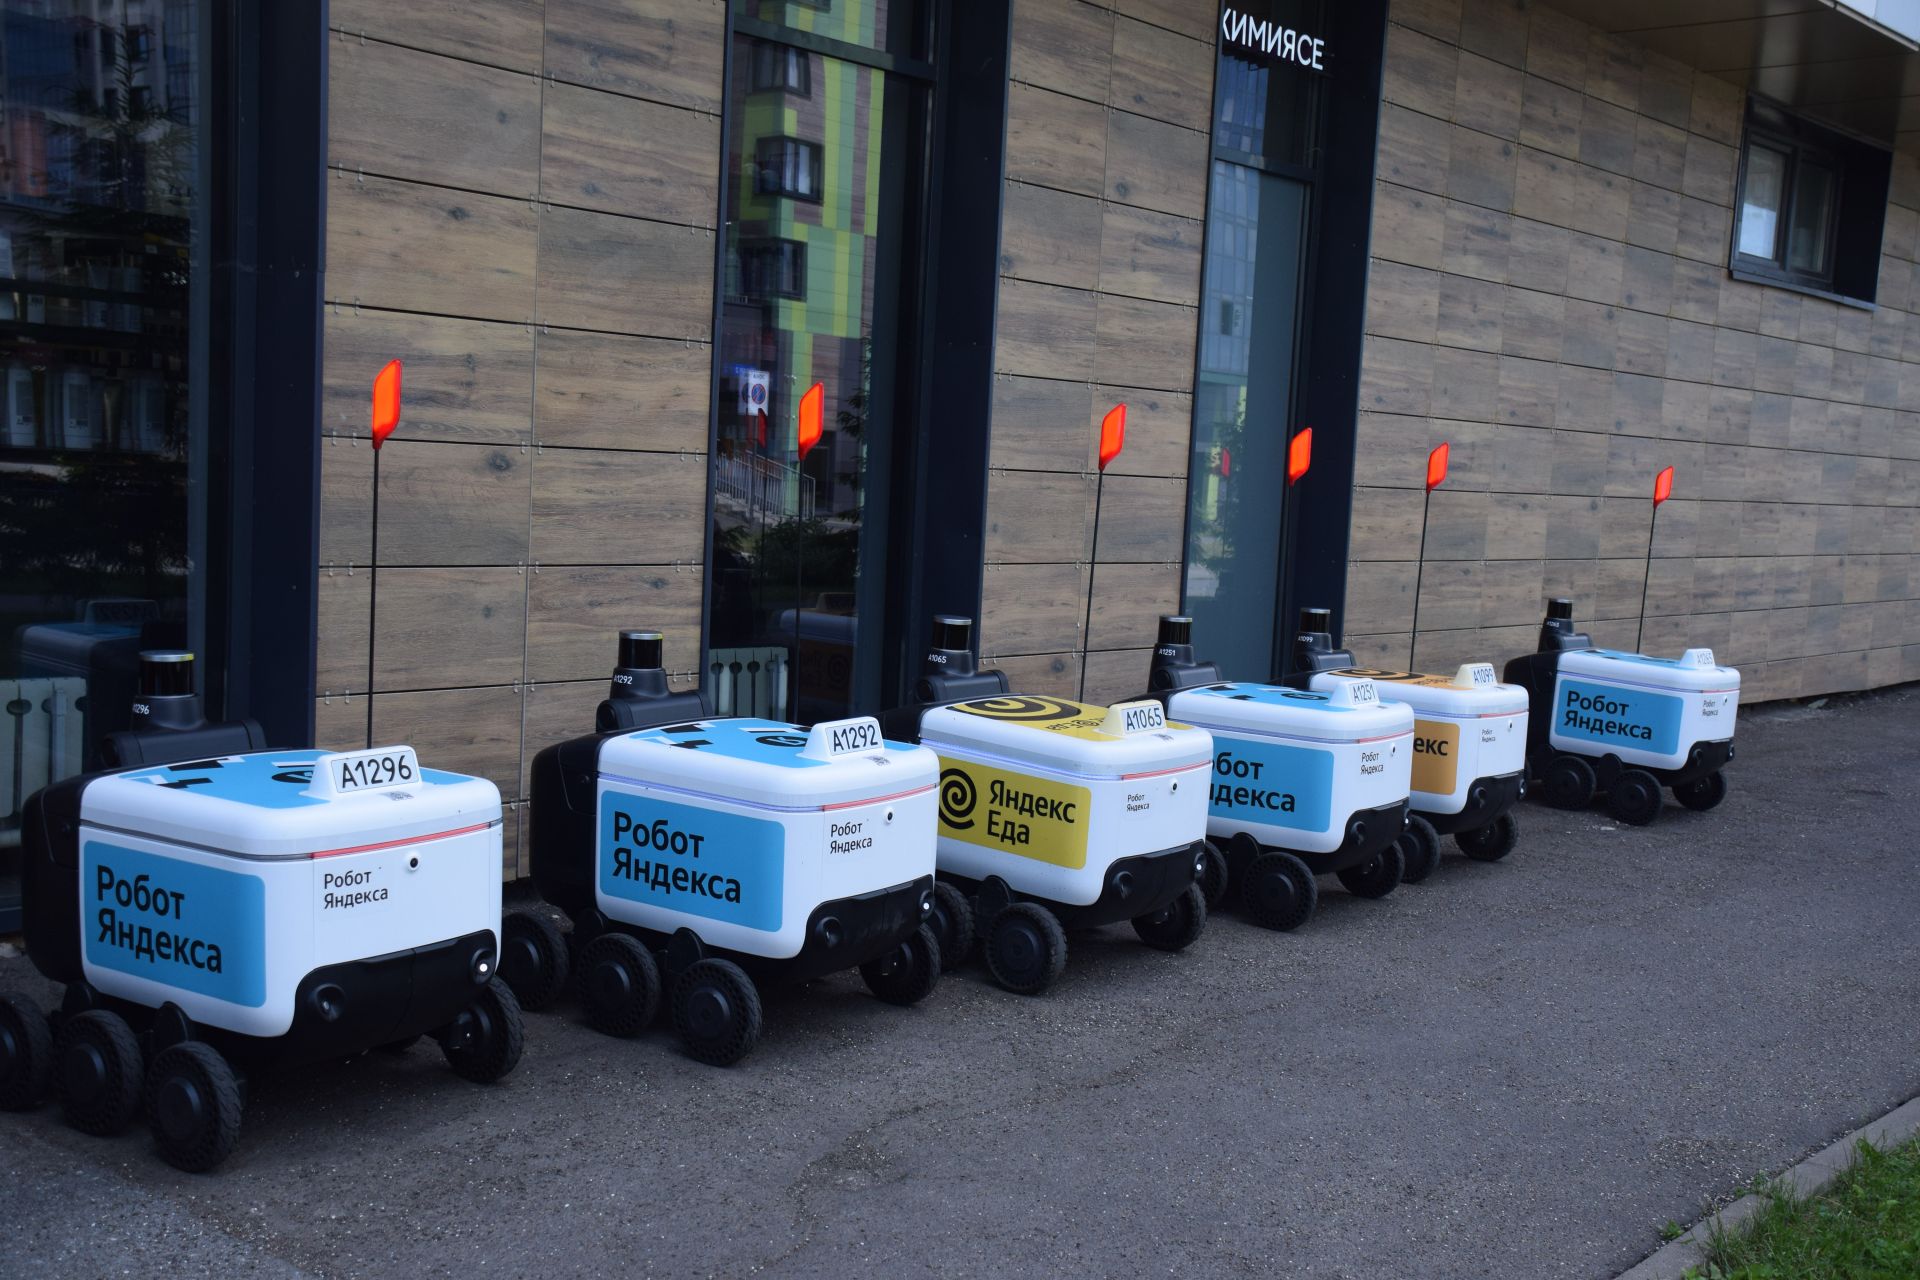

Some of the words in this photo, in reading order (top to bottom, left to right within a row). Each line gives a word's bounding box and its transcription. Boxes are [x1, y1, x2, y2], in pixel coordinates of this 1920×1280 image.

[928, 654, 947, 663] A1065
[1158, 648, 1176, 657] A1251
[613, 674, 632, 684] A1292
[1473, 668, 1494, 684] A1099
[1353, 684, 1376, 701] A1251
[1566, 690, 1629, 717] Робот
[1126, 707, 1162, 731] A1065
[1565, 710, 1652, 740] Яндекса
[832, 724, 879, 752] A1292
[1212, 751, 1264, 781] бот
[1360, 763, 1384, 776] Яндекса
[1361, 751, 1380, 764] Робот
[341, 754, 413, 790] A1296
[989, 780, 1076, 824] Яндекс
[1125, 802, 1150, 813] Яндекса
[1126, 794, 1145, 804] Робот
[613, 811, 705, 859] Робот
[830, 822, 863, 839] Робот
[987, 810, 1030, 845] Еда
[829, 836, 873, 855] Яндекса
[323, 869, 372, 890] Робот
[611, 847, 741, 904] Яндекса
[97, 864, 185, 921] Робот
[323, 886, 389, 911] Яндекса
[97, 907, 223, 975] Яндекса
